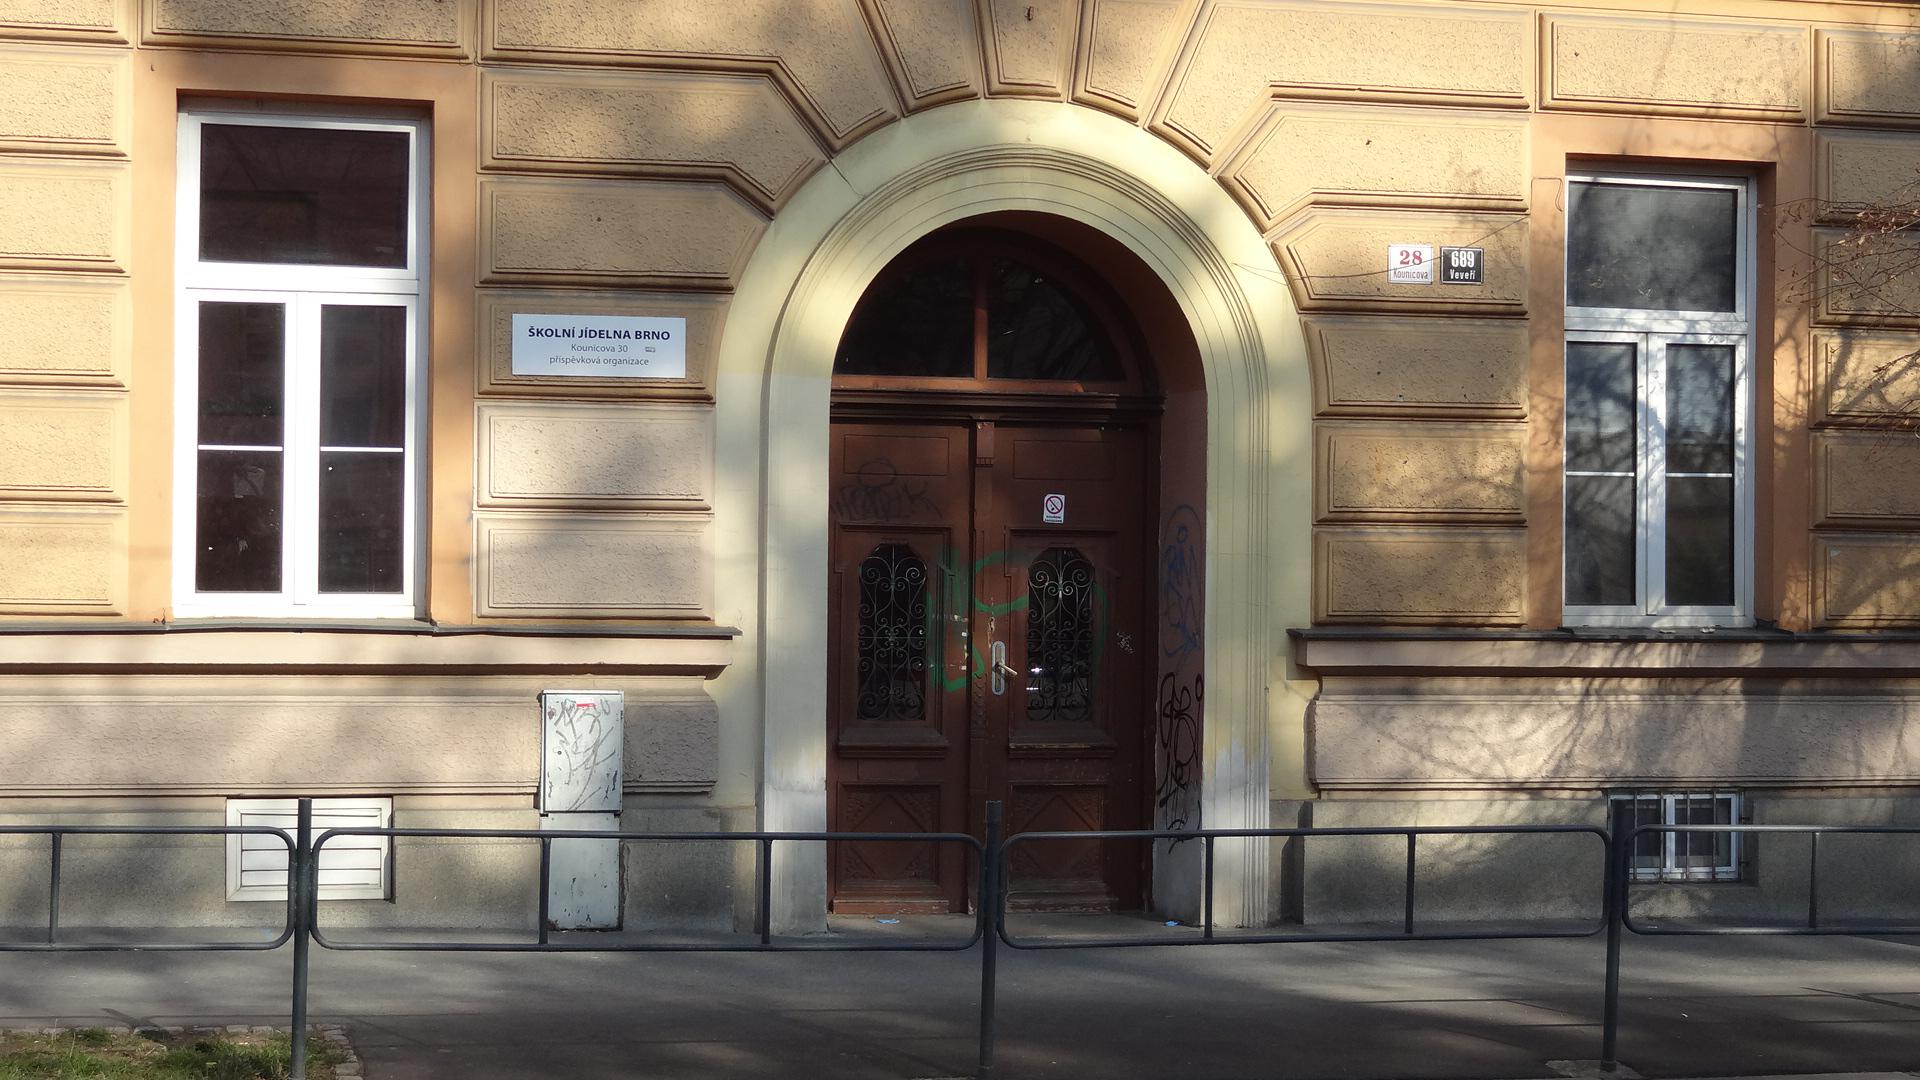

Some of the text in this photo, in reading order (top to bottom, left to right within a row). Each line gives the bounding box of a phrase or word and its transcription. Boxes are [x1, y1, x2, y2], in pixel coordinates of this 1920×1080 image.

[1400, 250, 1422, 265] 28
[1451, 251, 1475, 267] 689
[1393, 270, 1428, 279] Kounicova
[1449, 269, 1476, 280] Veveří
[528, 325, 671, 340] ŠKOLNÍ JÍDELNA BRNO
[571, 343, 628, 353] Kounicova 30
[549, 356, 649, 367] příspěvková organizace
